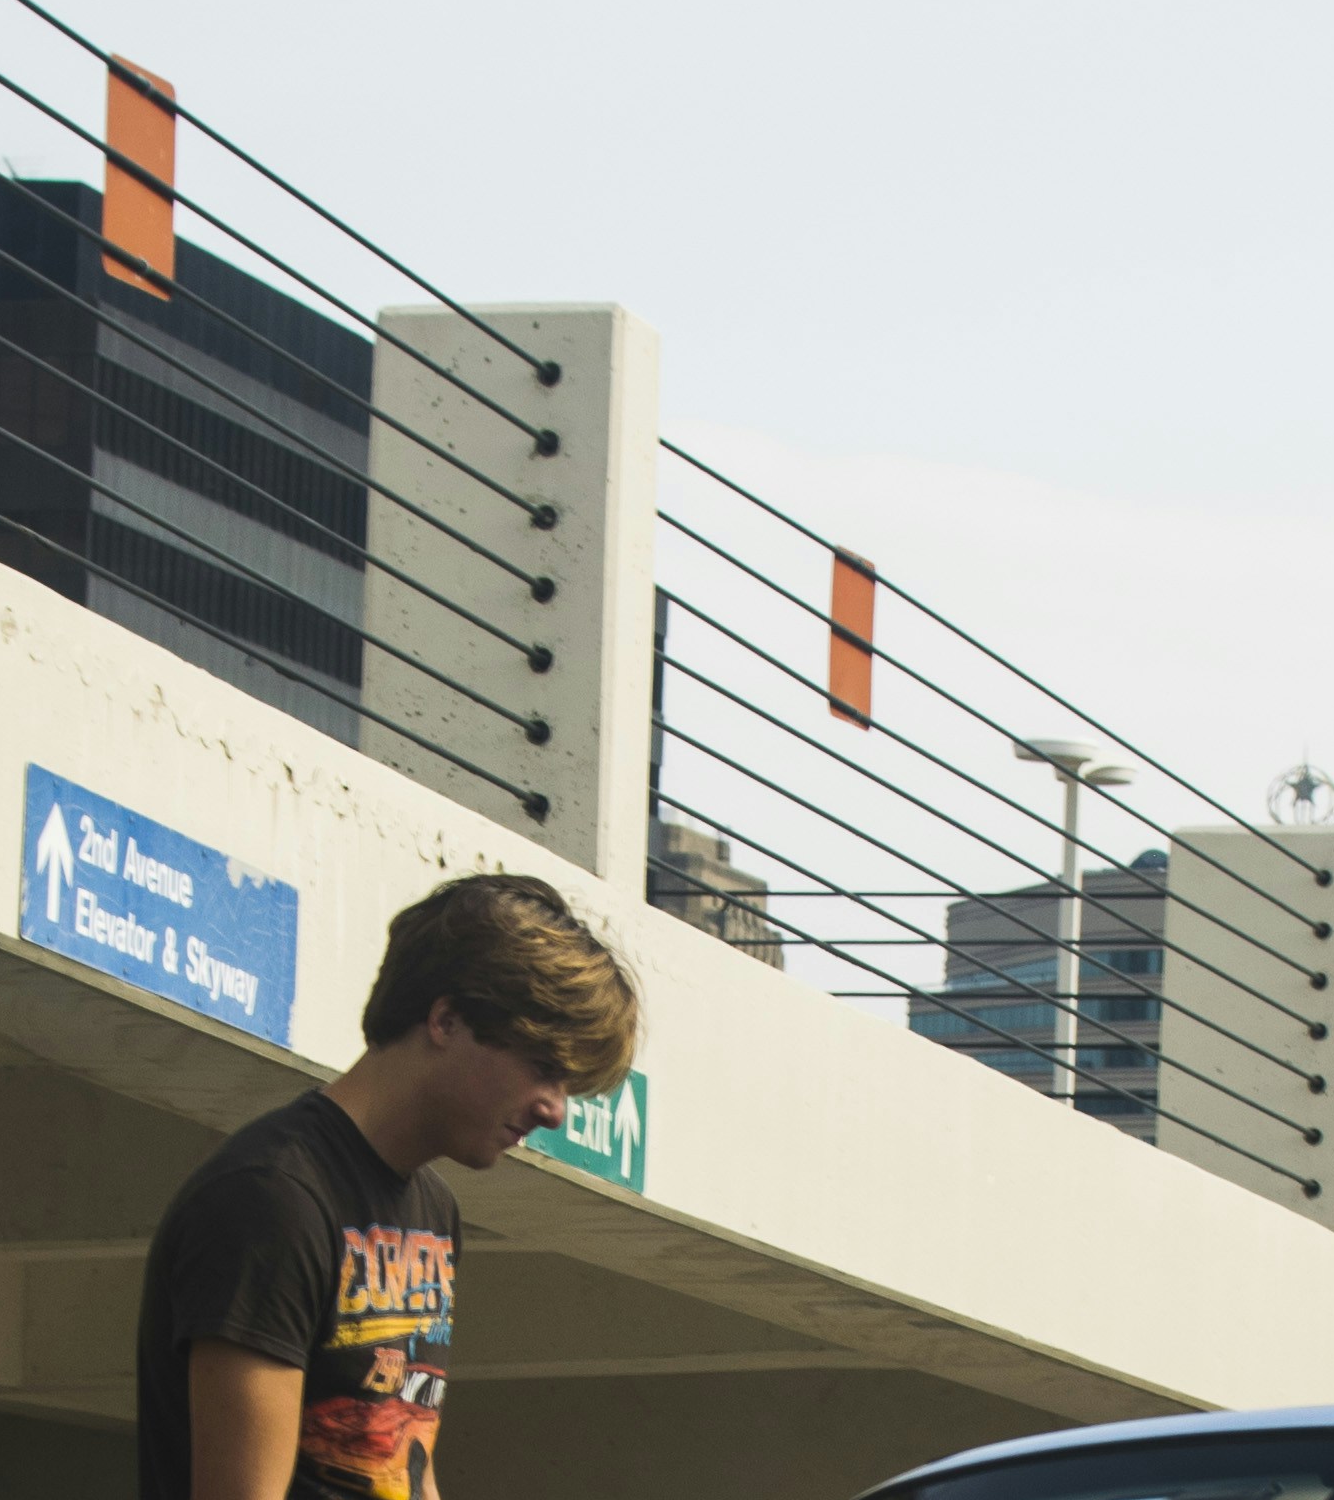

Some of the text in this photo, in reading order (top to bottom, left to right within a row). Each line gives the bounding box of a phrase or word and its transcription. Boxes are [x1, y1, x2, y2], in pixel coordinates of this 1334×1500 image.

[78, 814, 194, 909] 2nd Avenue
[74, 887, 259, 1016] Elevator & Skyway
[566, 1093, 612, 1157] Exit
